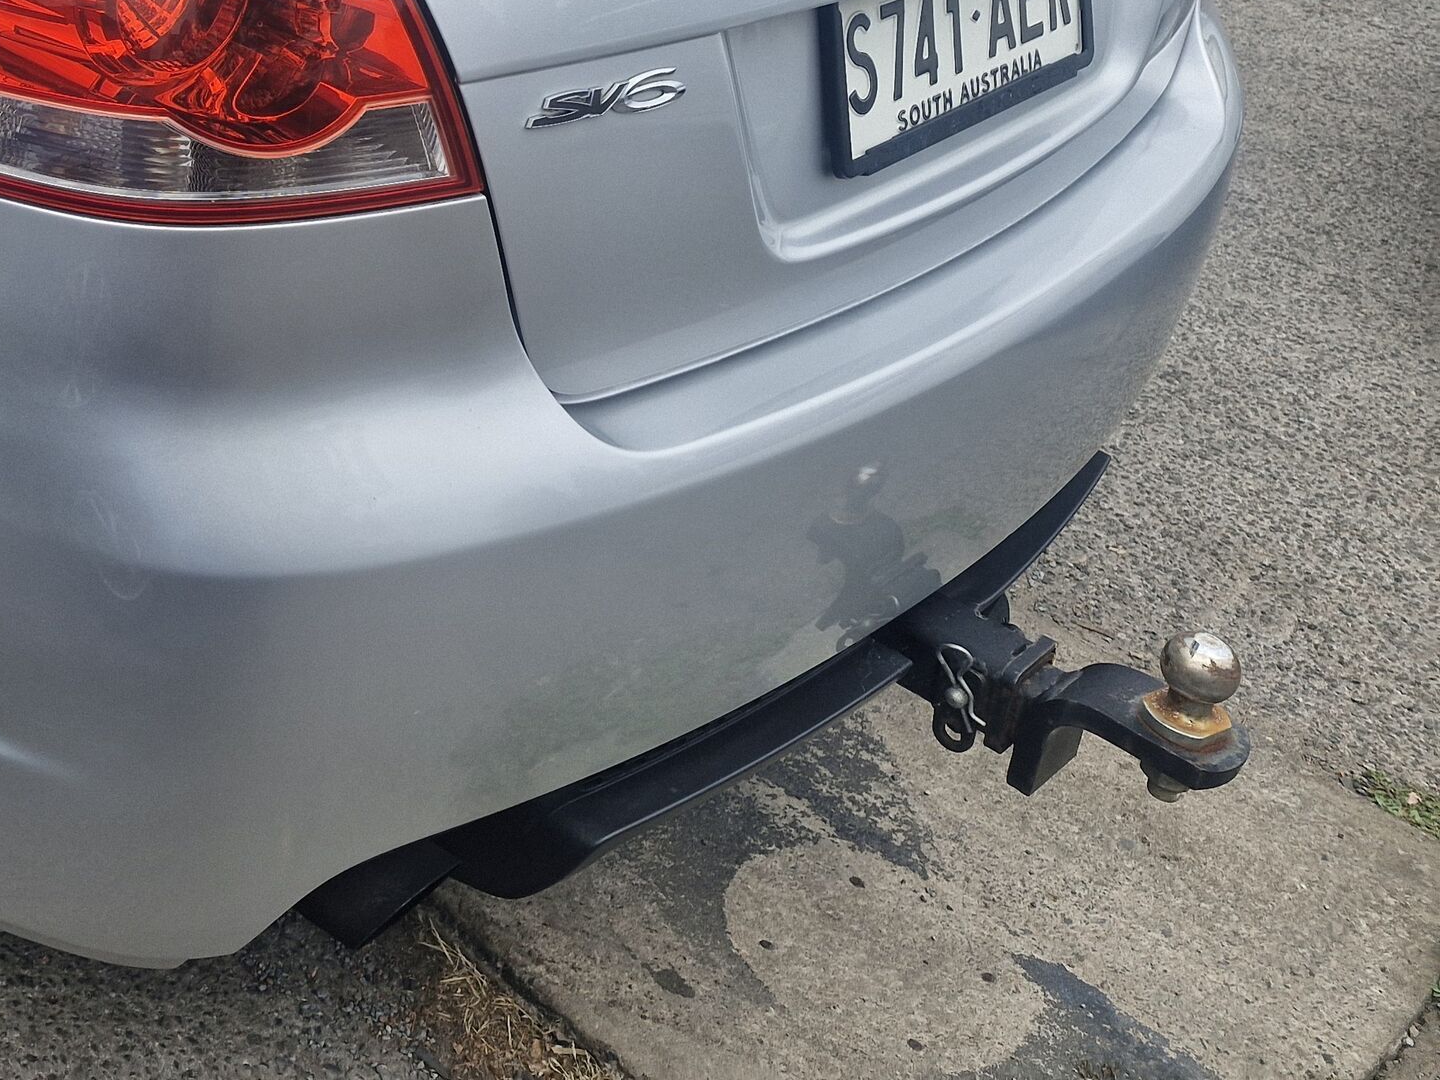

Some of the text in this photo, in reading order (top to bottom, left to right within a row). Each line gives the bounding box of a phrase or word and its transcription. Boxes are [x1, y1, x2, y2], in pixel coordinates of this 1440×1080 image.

[524, 66, 687, 130] SV6
[896, 48, 1043, 132] SOUTH AUSTRALIA
